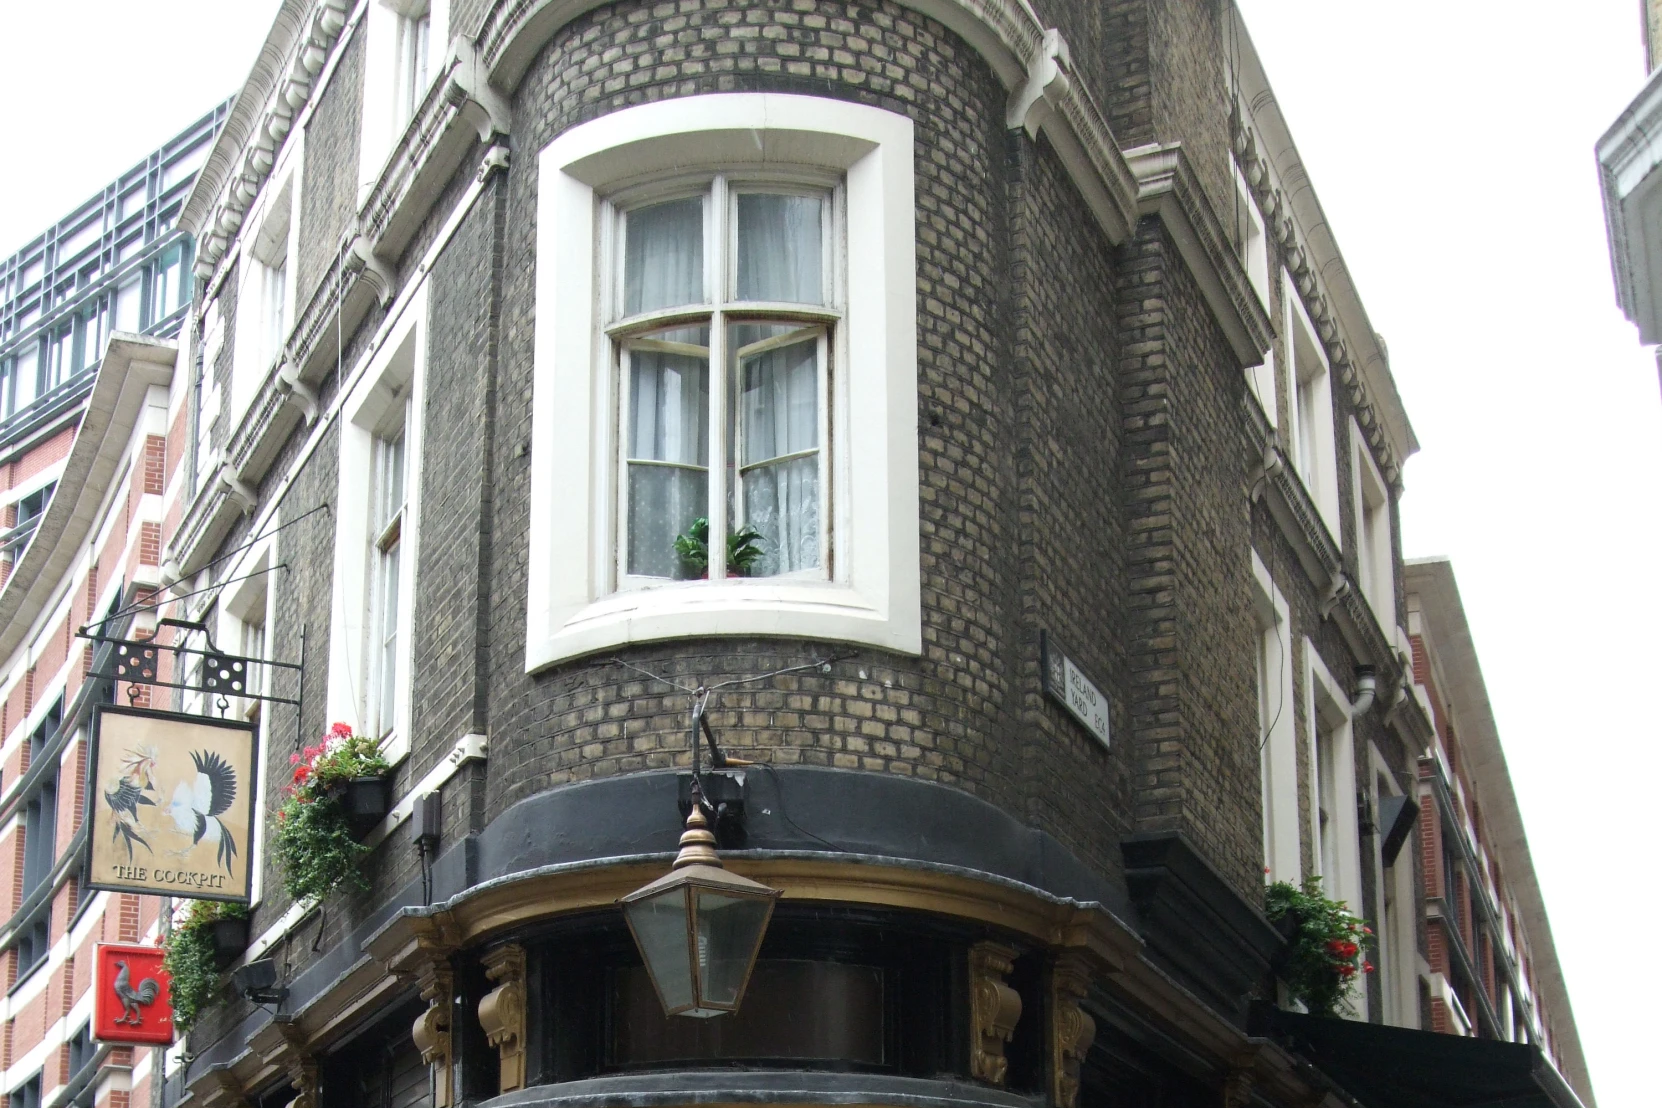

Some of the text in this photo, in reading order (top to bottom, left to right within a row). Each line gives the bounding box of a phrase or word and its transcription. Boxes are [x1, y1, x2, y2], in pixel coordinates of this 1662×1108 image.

[1070, 668, 1096, 706] IRELAND
[1071, 688, 1088, 716] YARD
[1094, 714, 1106, 736] EC4
[113, 865, 226, 889] THE COCKPIT
